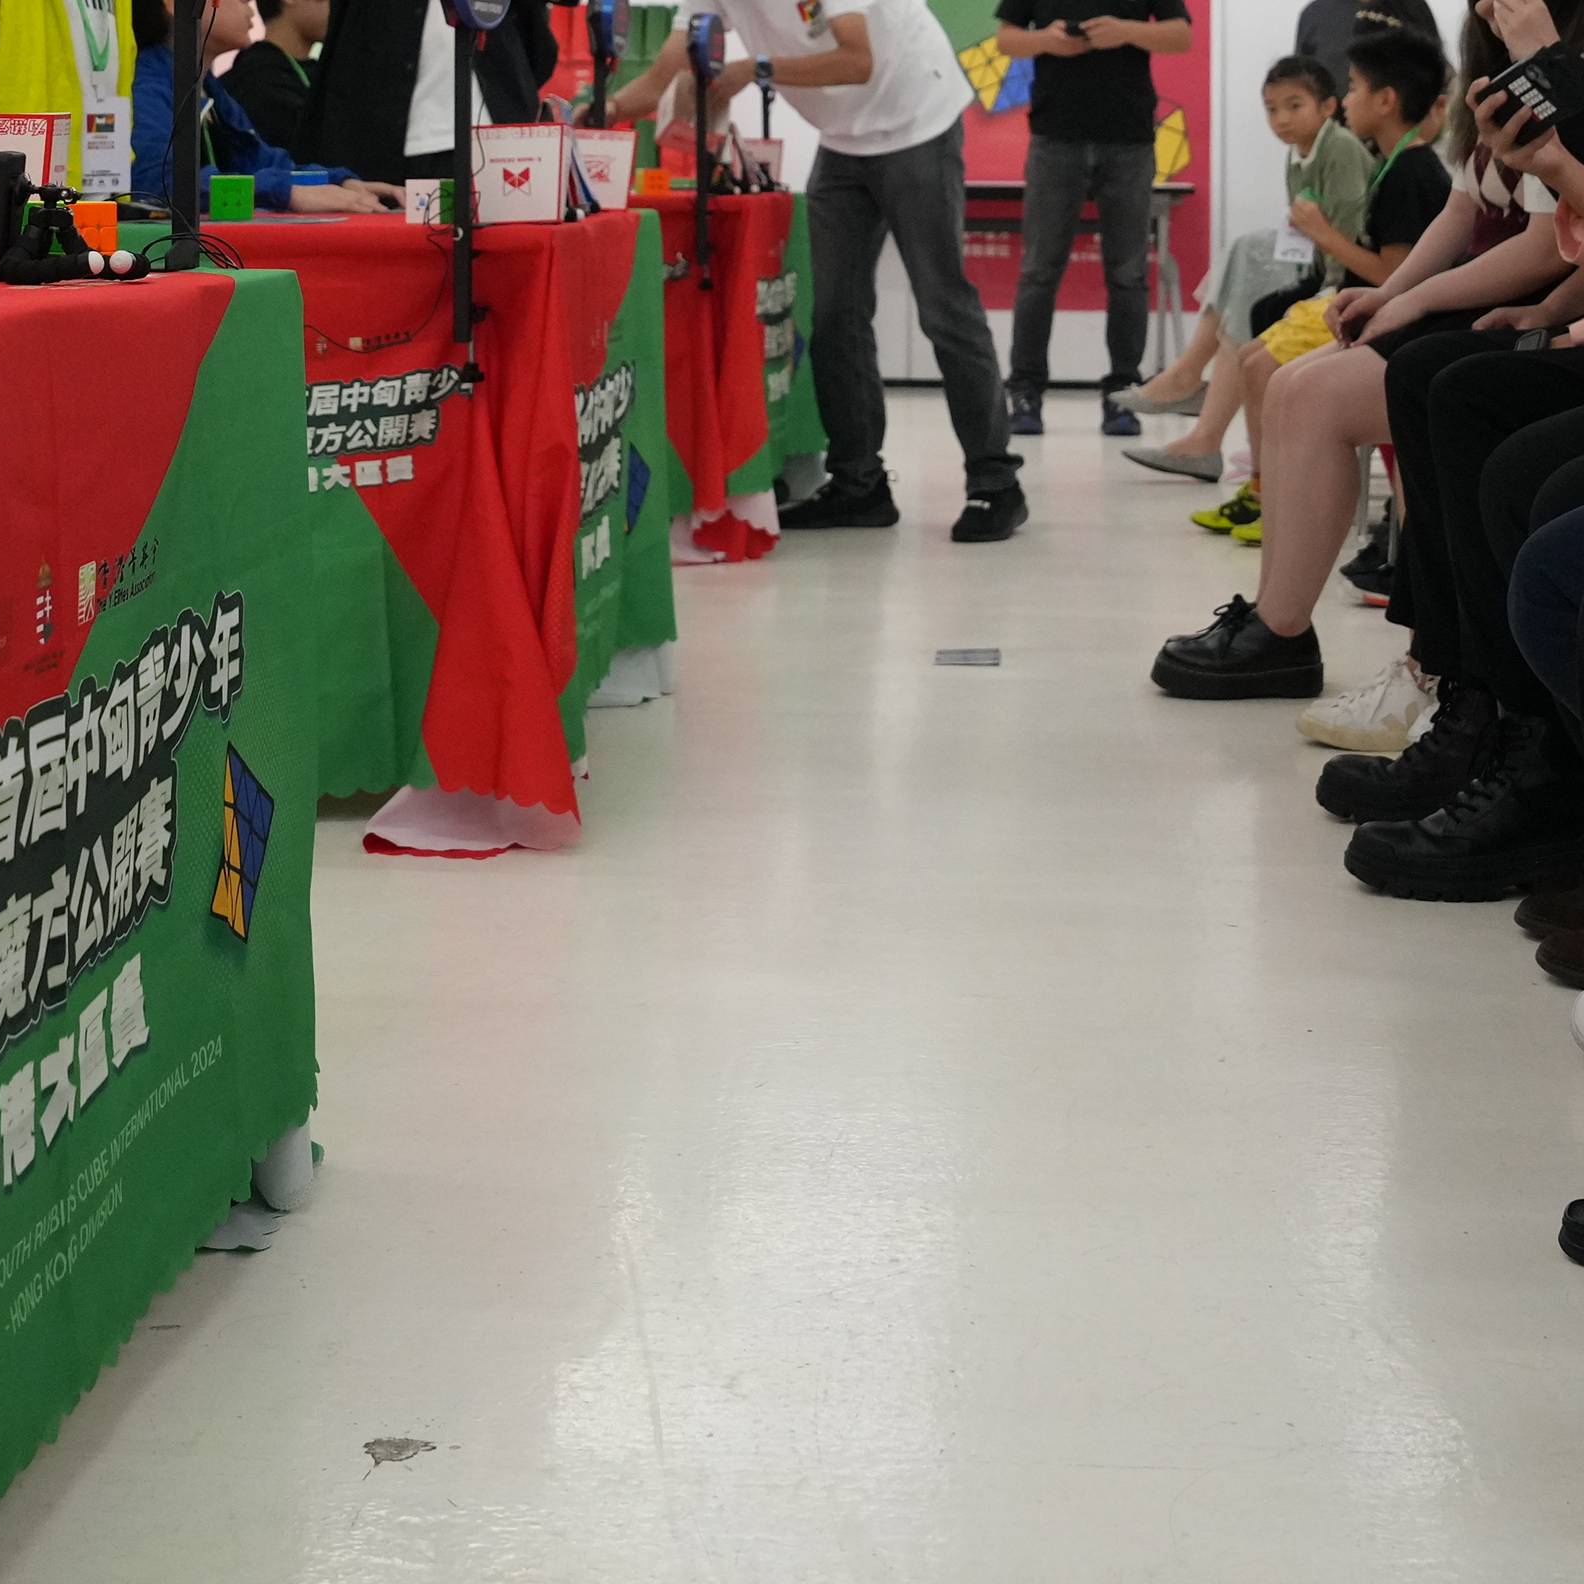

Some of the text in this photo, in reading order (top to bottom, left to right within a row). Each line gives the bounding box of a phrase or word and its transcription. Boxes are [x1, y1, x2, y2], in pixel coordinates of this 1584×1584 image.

[77, 1148, 109, 1201] CUBE
[110, 1074, 190, 1167] INTERNATIONAL
[192, 1034, 223, 1079] 2024
